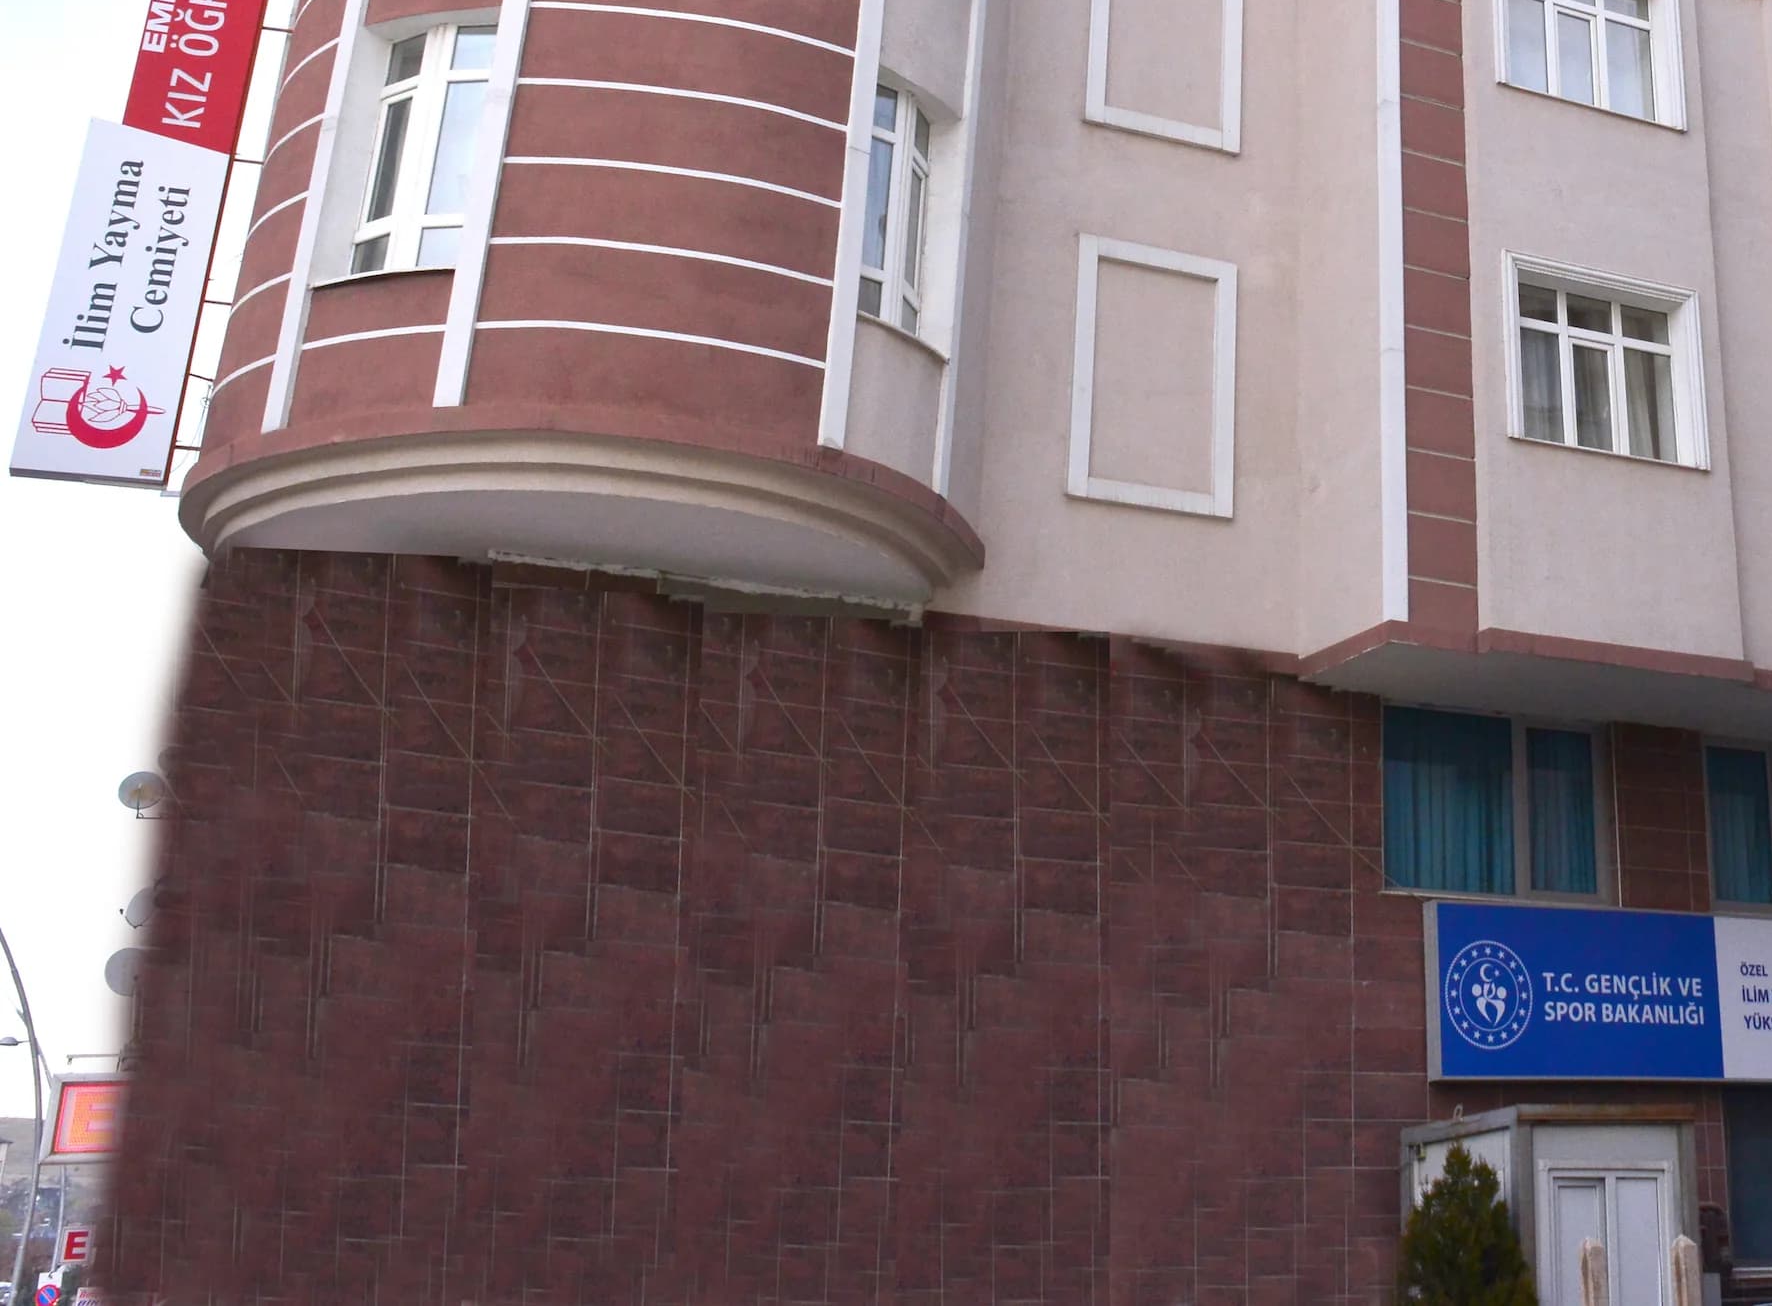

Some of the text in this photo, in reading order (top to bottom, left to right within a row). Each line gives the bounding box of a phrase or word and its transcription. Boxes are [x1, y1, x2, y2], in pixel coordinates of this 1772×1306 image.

[161, 68, 212, 128] KIZ
[62, 160, 144, 352] İlim Yayma
[130, 186, 191, 333] Cemiyeti
[1740, 961, 1768, 977] ÖZEL
[1542, 972, 1702, 1000] T.C. GENÇLİK VE
[1742, 984, 1769, 1003] İLİM
[1544, 1002, 1704, 1025] SPOR BAKANLIĞI
[63, 1231, 89, 1261] E
